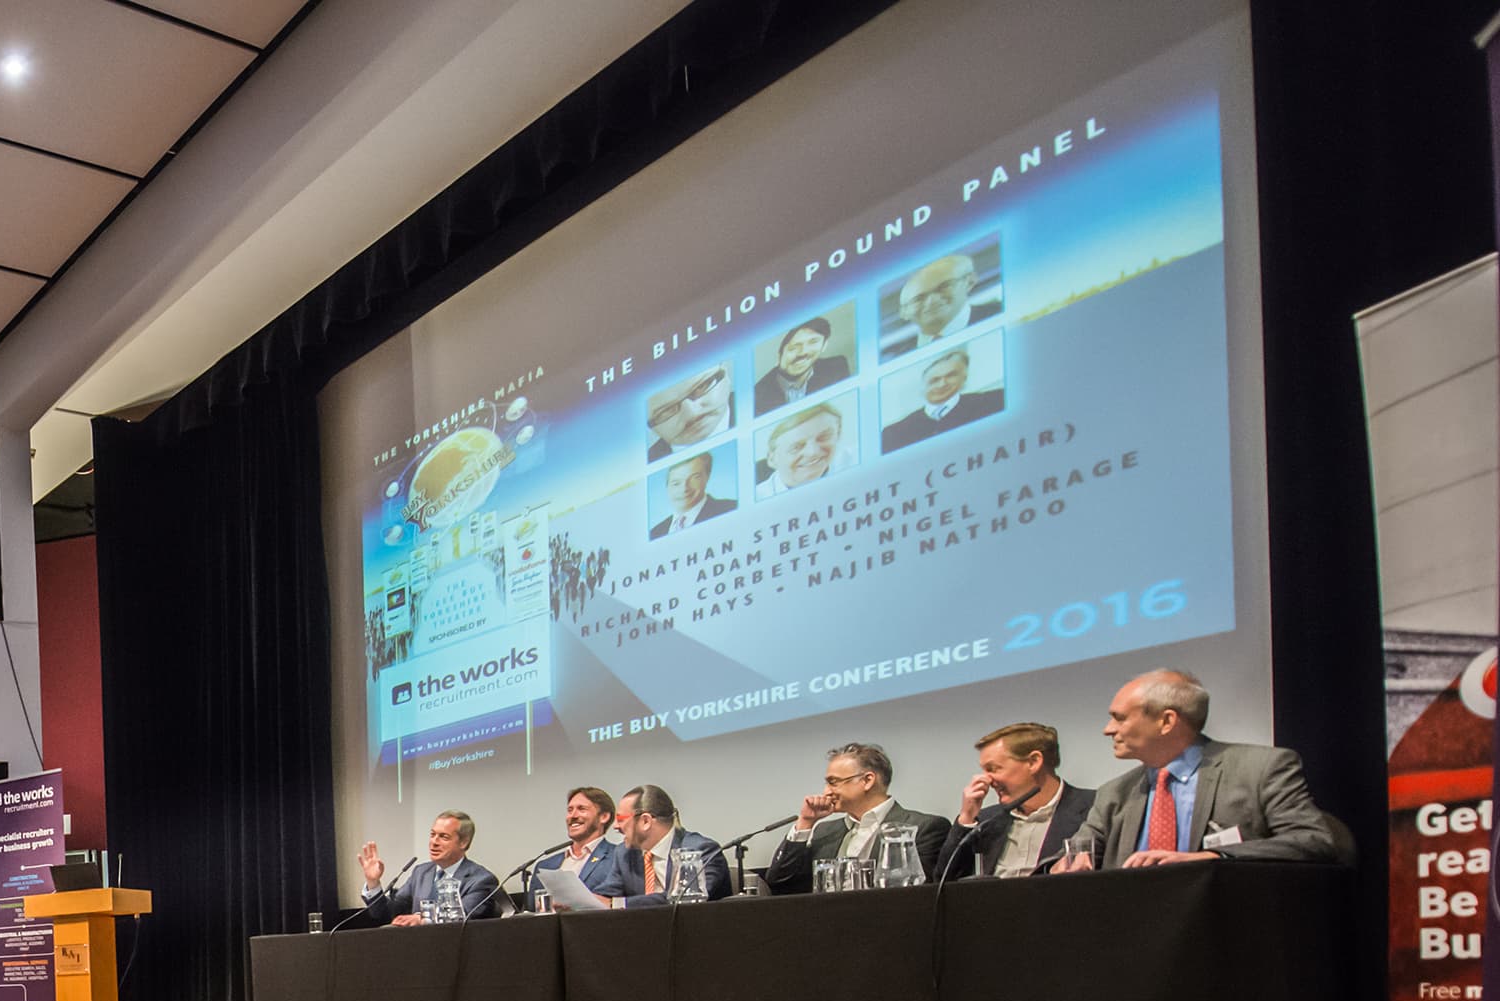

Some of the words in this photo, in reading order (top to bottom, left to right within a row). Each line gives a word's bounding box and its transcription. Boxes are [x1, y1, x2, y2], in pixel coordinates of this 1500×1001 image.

[586, 358, 633, 393] THE
[653, 282, 781, 360] BILLION
[804, 205, 932, 283] POUND
[963, 117, 1106, 202] PANEL
[373, 447, 397, 466] THE
[404, 398, 486, 449] YORKSHIRE
[494, 366, 544, 400] MAFIA
[610, 539, 734, 595] JONATHAN
[753, 482, 901, 544] STRAIGHT
[924, 421, 1078, 489] (CHAIR)
[580, 597, 680, 638] RICHARD
[697, 551, 820, 602] CORBETT
[879, 504, 975, 545] NIGEL
[999, 450, 1142, 509] FARAGE
[696, 550, 763, 582] ADAM
[780, 490, 940, 556] BEAUMONT
[616, 616, 675, 648] JOHN
[692, 592, 756, 623] HAYS
[808, 549, 896, 588] NAJIB
[919, 498, 1069, 555] NATHOO
[417, 672, 456, 699] the
[459, 646, 539, 682] works
[588, 725, 624, 744] THE
[629, 713, 668, 735] BUY
[676, 681, 801, 723] YORKSHIRE
[809, 638, 990, 694] CONFERENCE
[1003, 578, 1188, 653] 2016
[419, 669, 539, 712] recruitment.com
[403, 718, 524, 756] www.buyyorkshire.com
[428, 749, 495, 771] #BuyYorkshire
[3, 791, 21, 805] the
[21, 785, 54, 802] works
[1416, 799, 1494, 836] Get
[32, 838, 54, 850] growth
[1418, 886, 1479, 919] Be
[1419, 982, 1462, 999] Free
